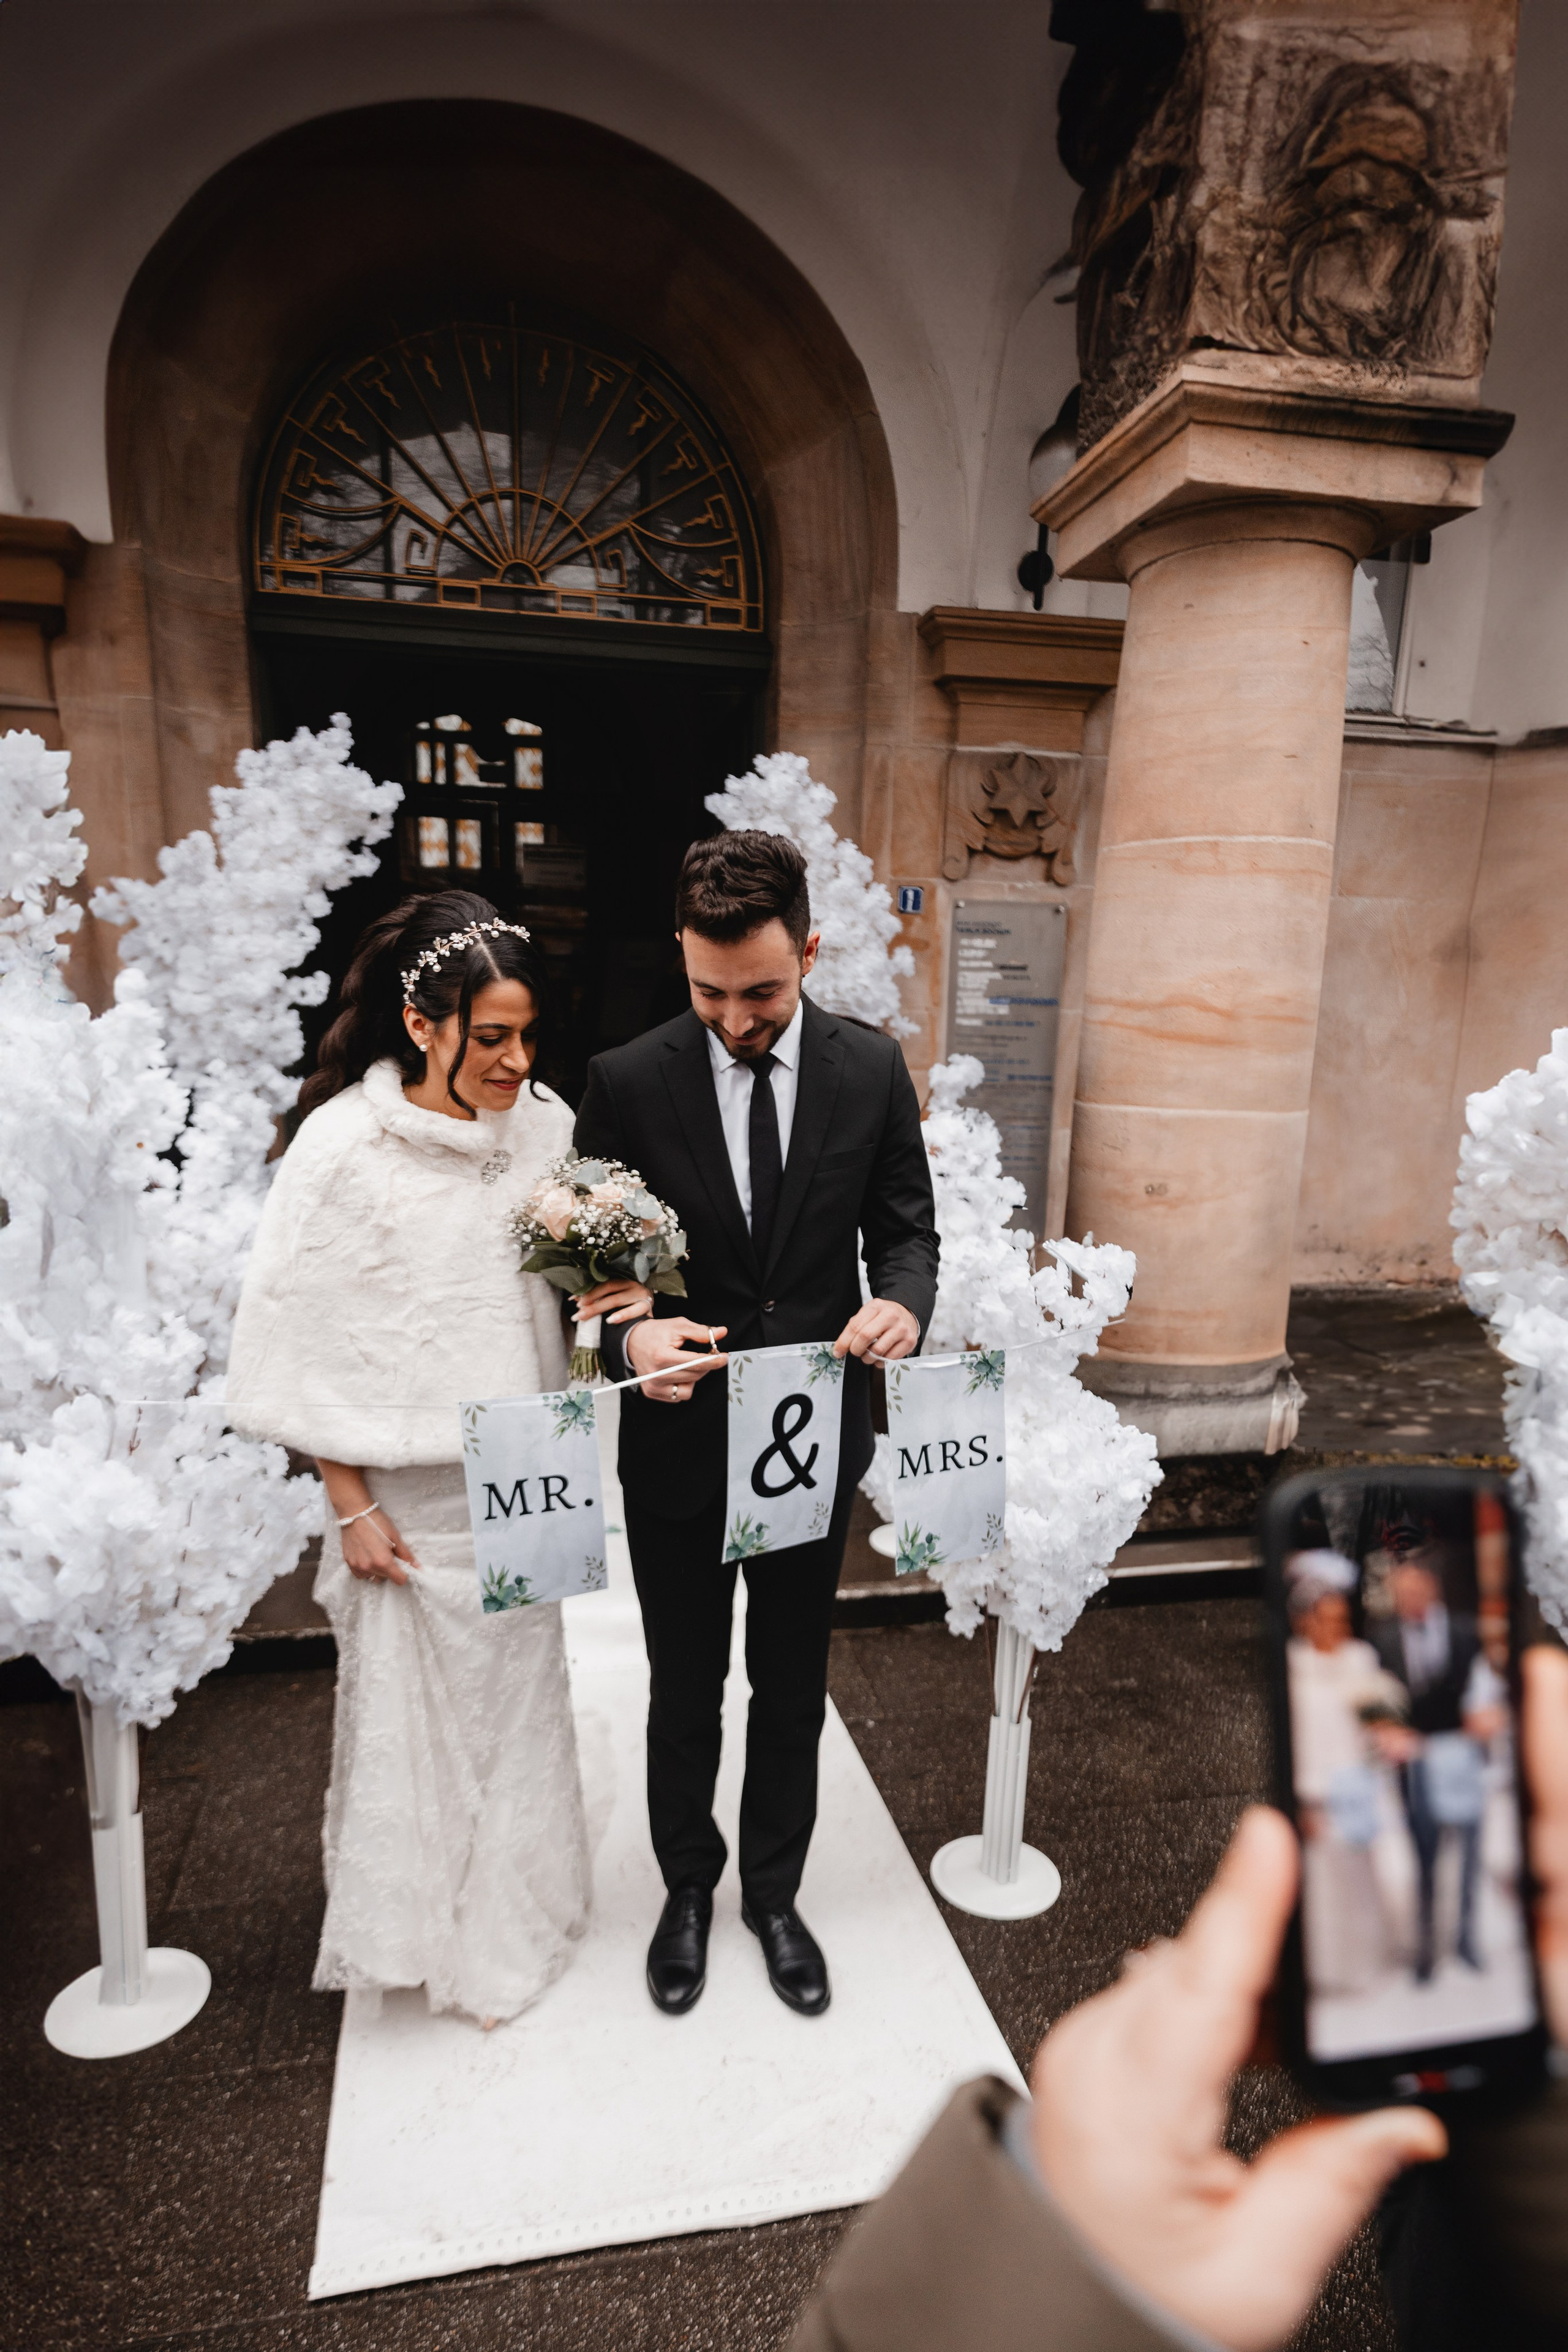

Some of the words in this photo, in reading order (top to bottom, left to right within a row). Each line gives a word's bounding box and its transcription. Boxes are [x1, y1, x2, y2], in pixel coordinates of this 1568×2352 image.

[482, 1474, 594, 1521] MR.
[750, 1393, 820, 1498] &
[897, 1434, 1003, 1479] MRS.
